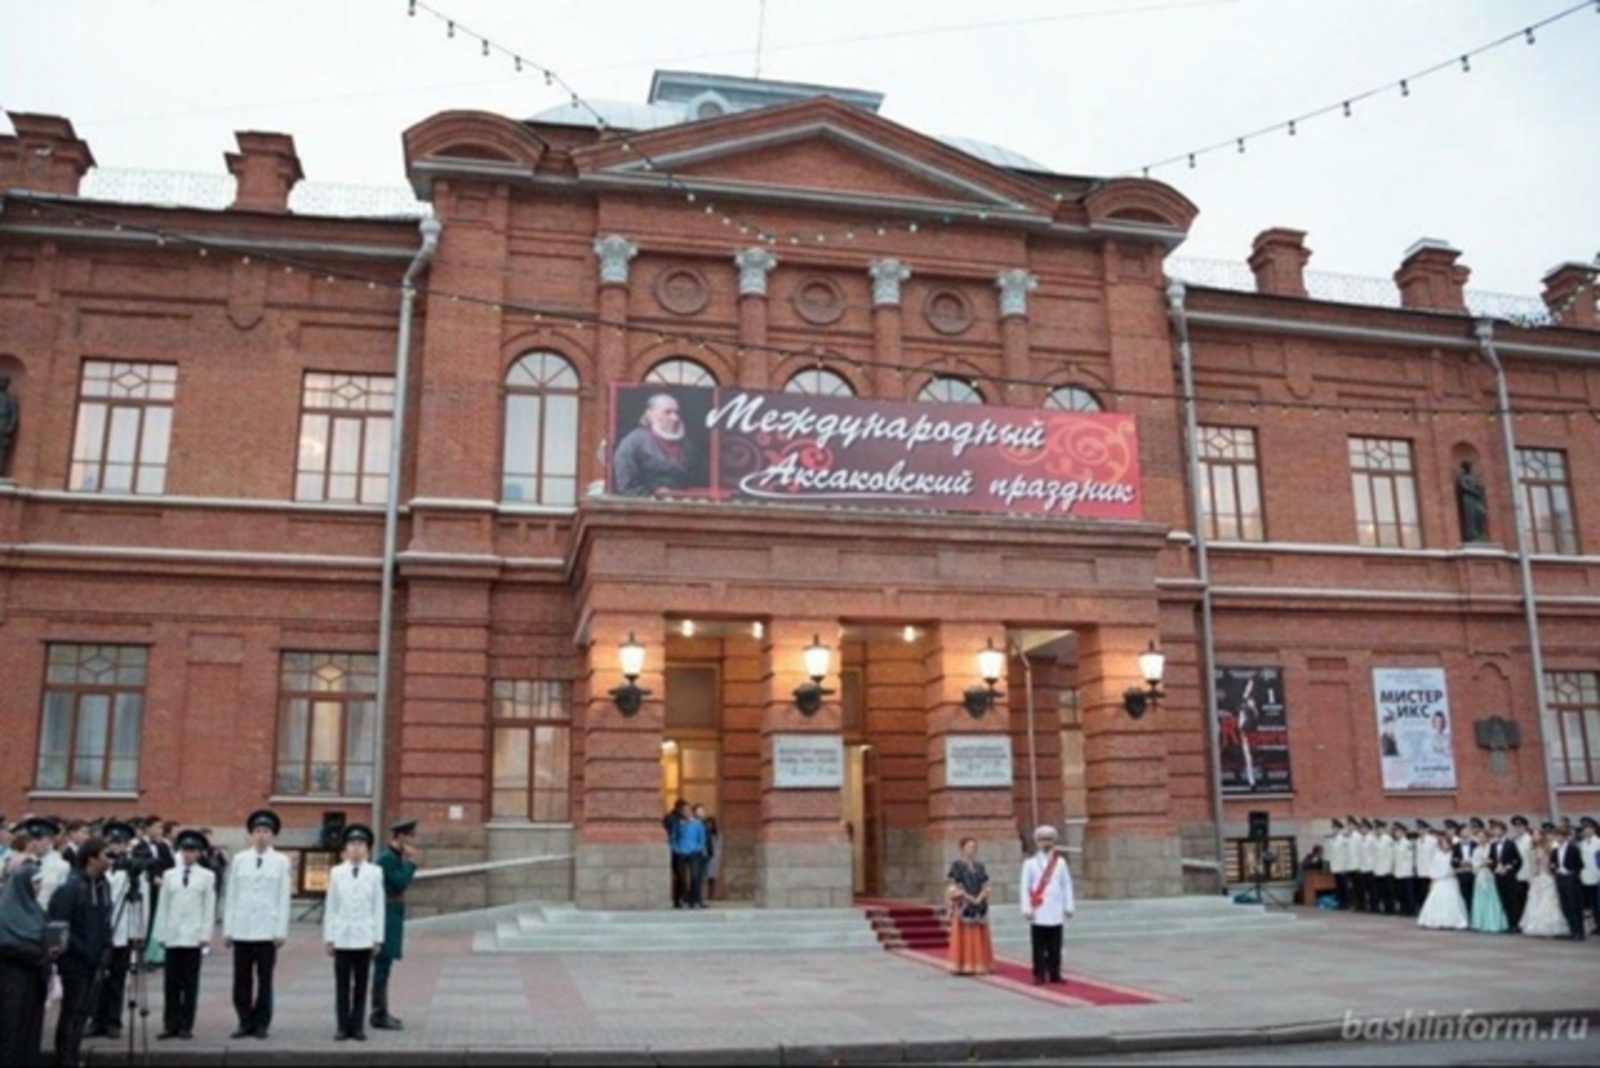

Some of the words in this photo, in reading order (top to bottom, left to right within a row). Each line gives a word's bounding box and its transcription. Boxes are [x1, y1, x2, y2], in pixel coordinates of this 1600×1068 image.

[705, 393, 1046, 456] Международный
[741, 452, 973, 498] Аксаковский
[988, 473, 1135, 511] праздник
[1380, 689, 1443, 703] МИСТЕР
[1397, 704, 1431, 719] ИКС
